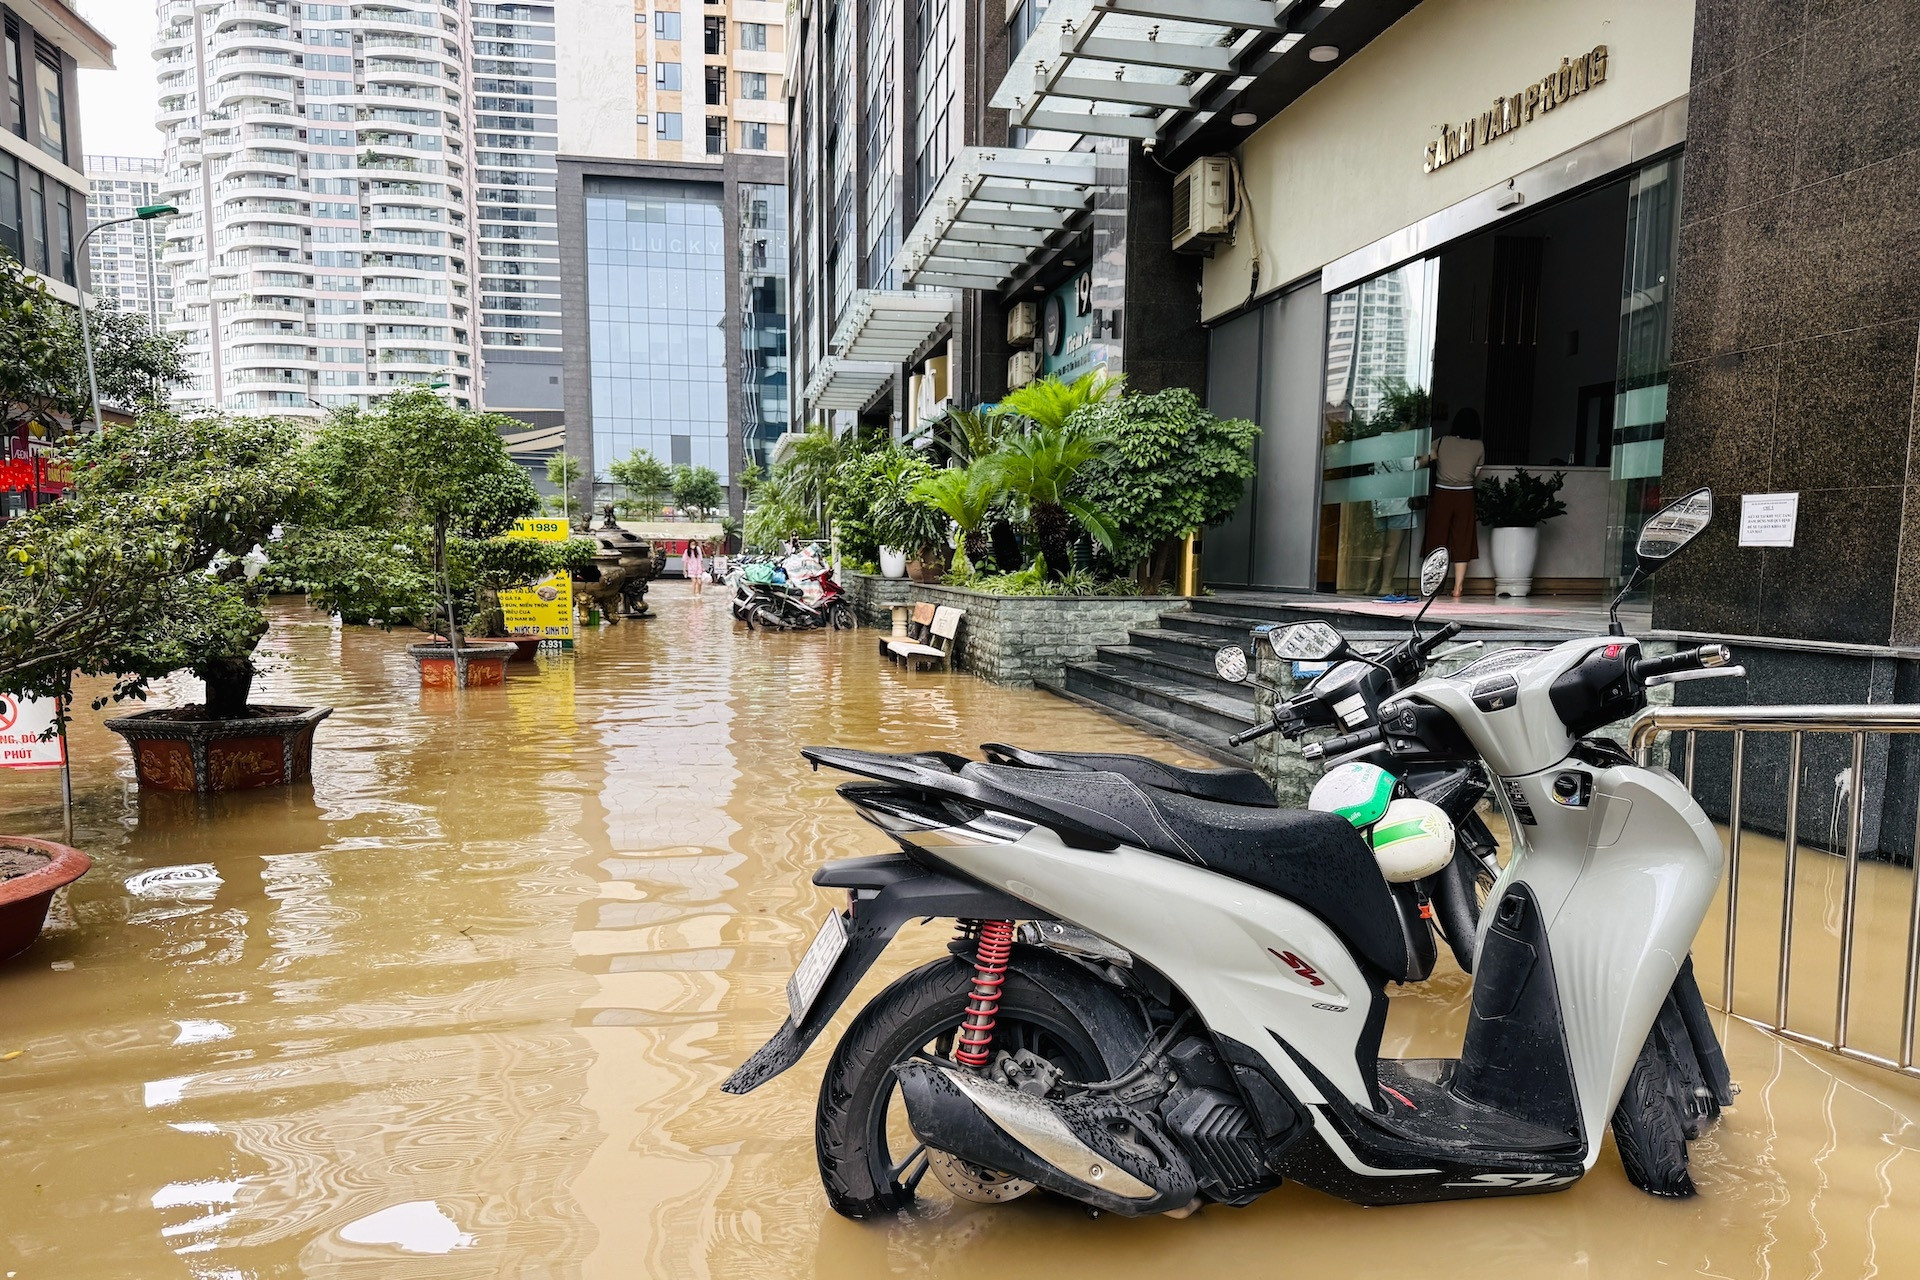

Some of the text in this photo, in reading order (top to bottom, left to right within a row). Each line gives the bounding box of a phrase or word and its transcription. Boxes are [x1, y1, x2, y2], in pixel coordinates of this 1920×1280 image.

[631, 237, 720, 254] LUCKY
[529, 523, 558, 532] 1989
[545, 626, 559, 635] SINH
[4, 748, 32, 759] PHÚT
